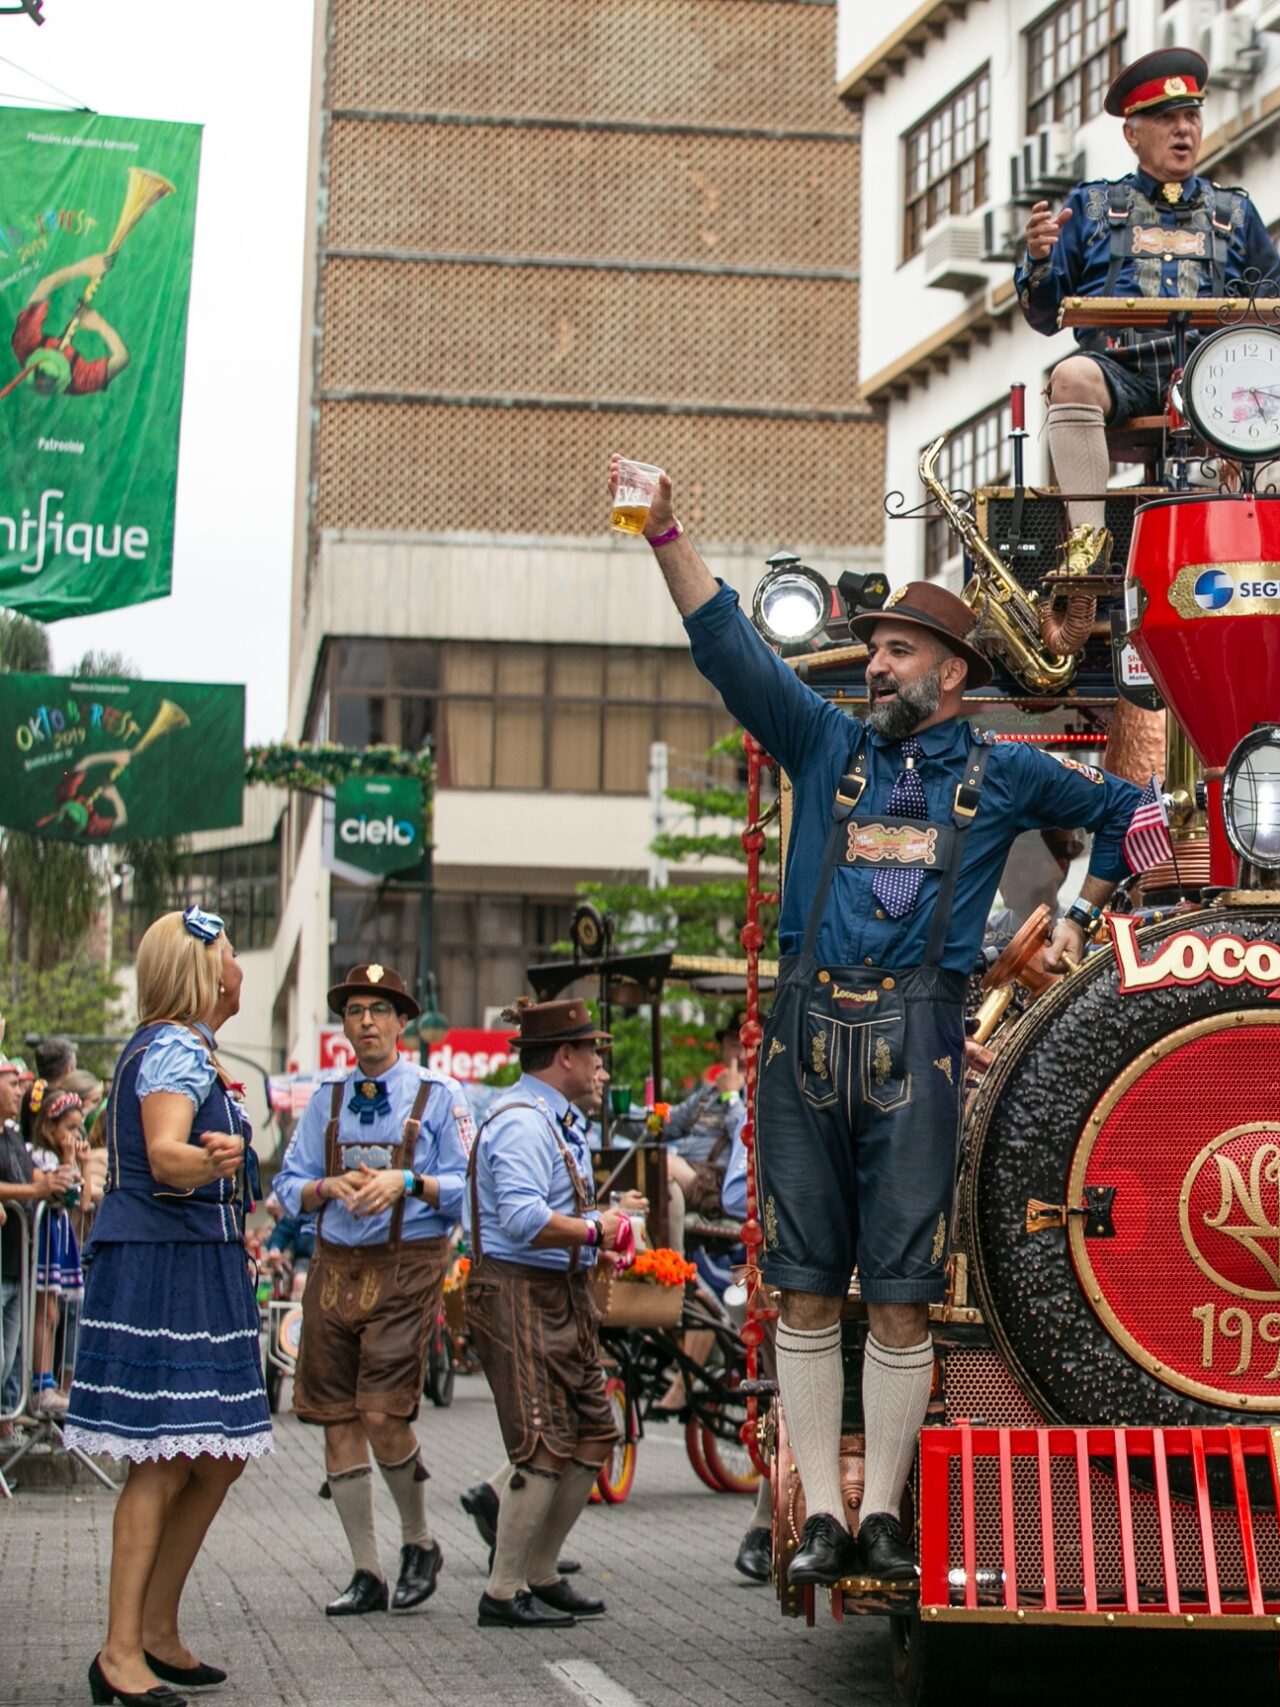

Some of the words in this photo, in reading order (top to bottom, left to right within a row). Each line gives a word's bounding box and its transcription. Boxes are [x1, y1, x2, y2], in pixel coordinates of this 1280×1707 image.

[1225, 350, 1236, 362] 11
[1243, 343, 1258, 357] 12
[1209, 365, 1223, 379] 10
[1205, 385, 1216, 398] 9
[1212, 406, 1223, 419] 8
[1229, 419, 1240, 433] 7
[1248, 424, 1259, 438] 6
[1270, 419, 1279, 433] 5
[340, 814, 415, 846] cielo
